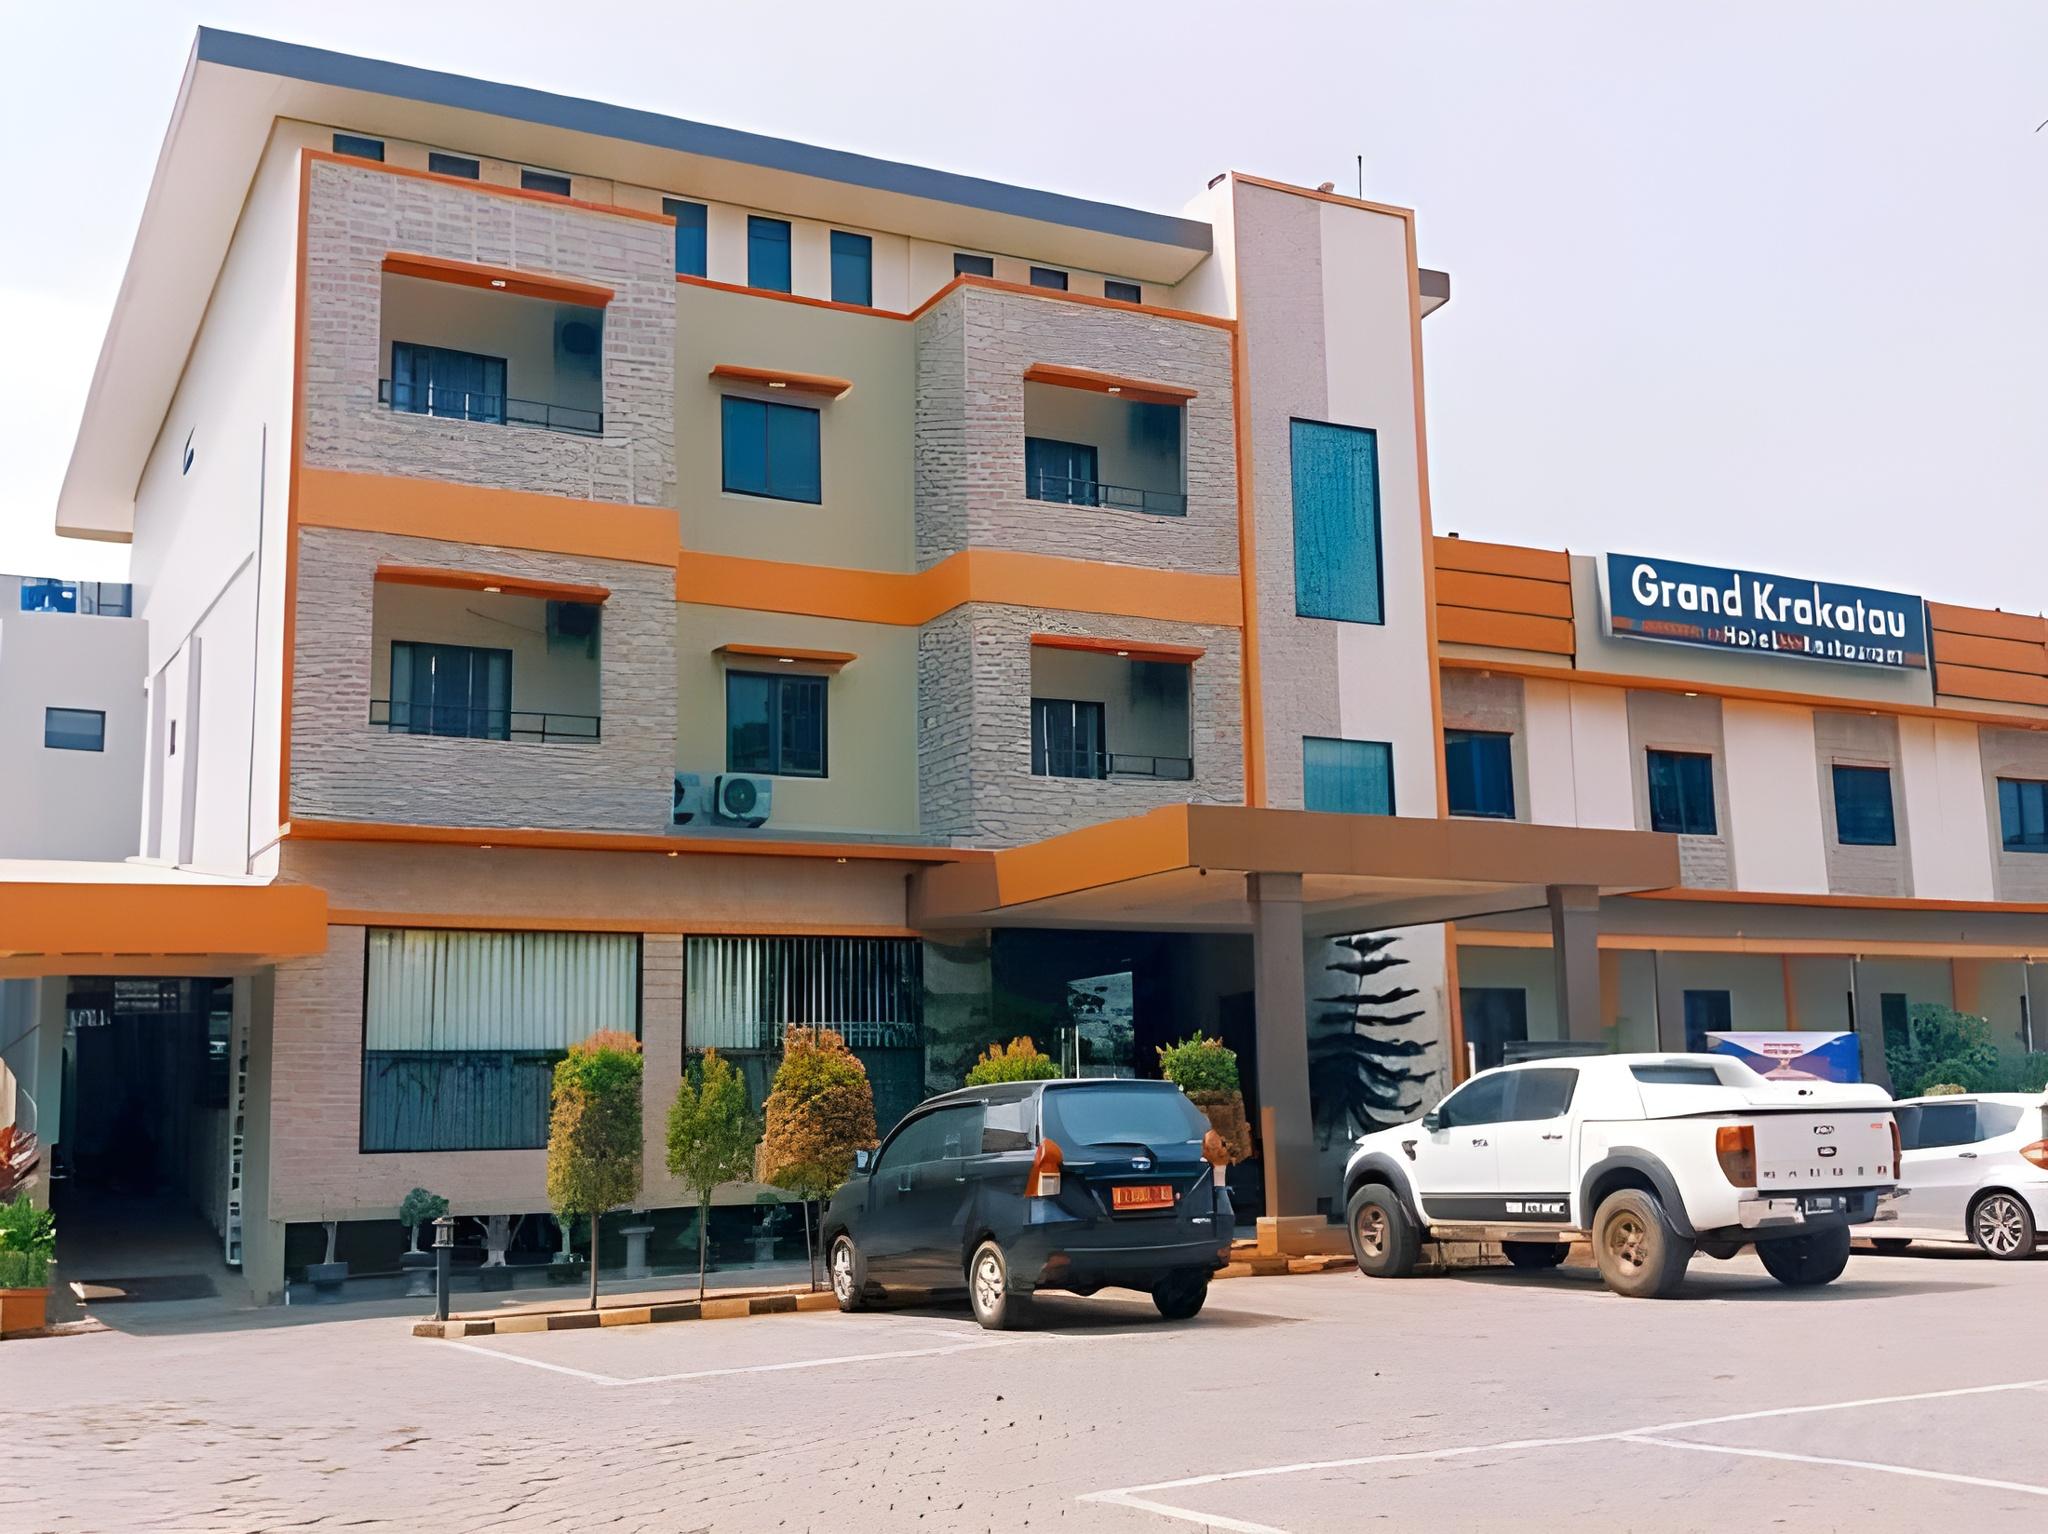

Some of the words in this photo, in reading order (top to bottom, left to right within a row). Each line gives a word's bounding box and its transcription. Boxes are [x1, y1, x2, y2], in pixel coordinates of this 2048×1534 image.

[1632, 563, 1742, 617] Grand
[1753, 580, 1906, 638] Krakatau
[1724, 625, 1779, 650] Hotel
